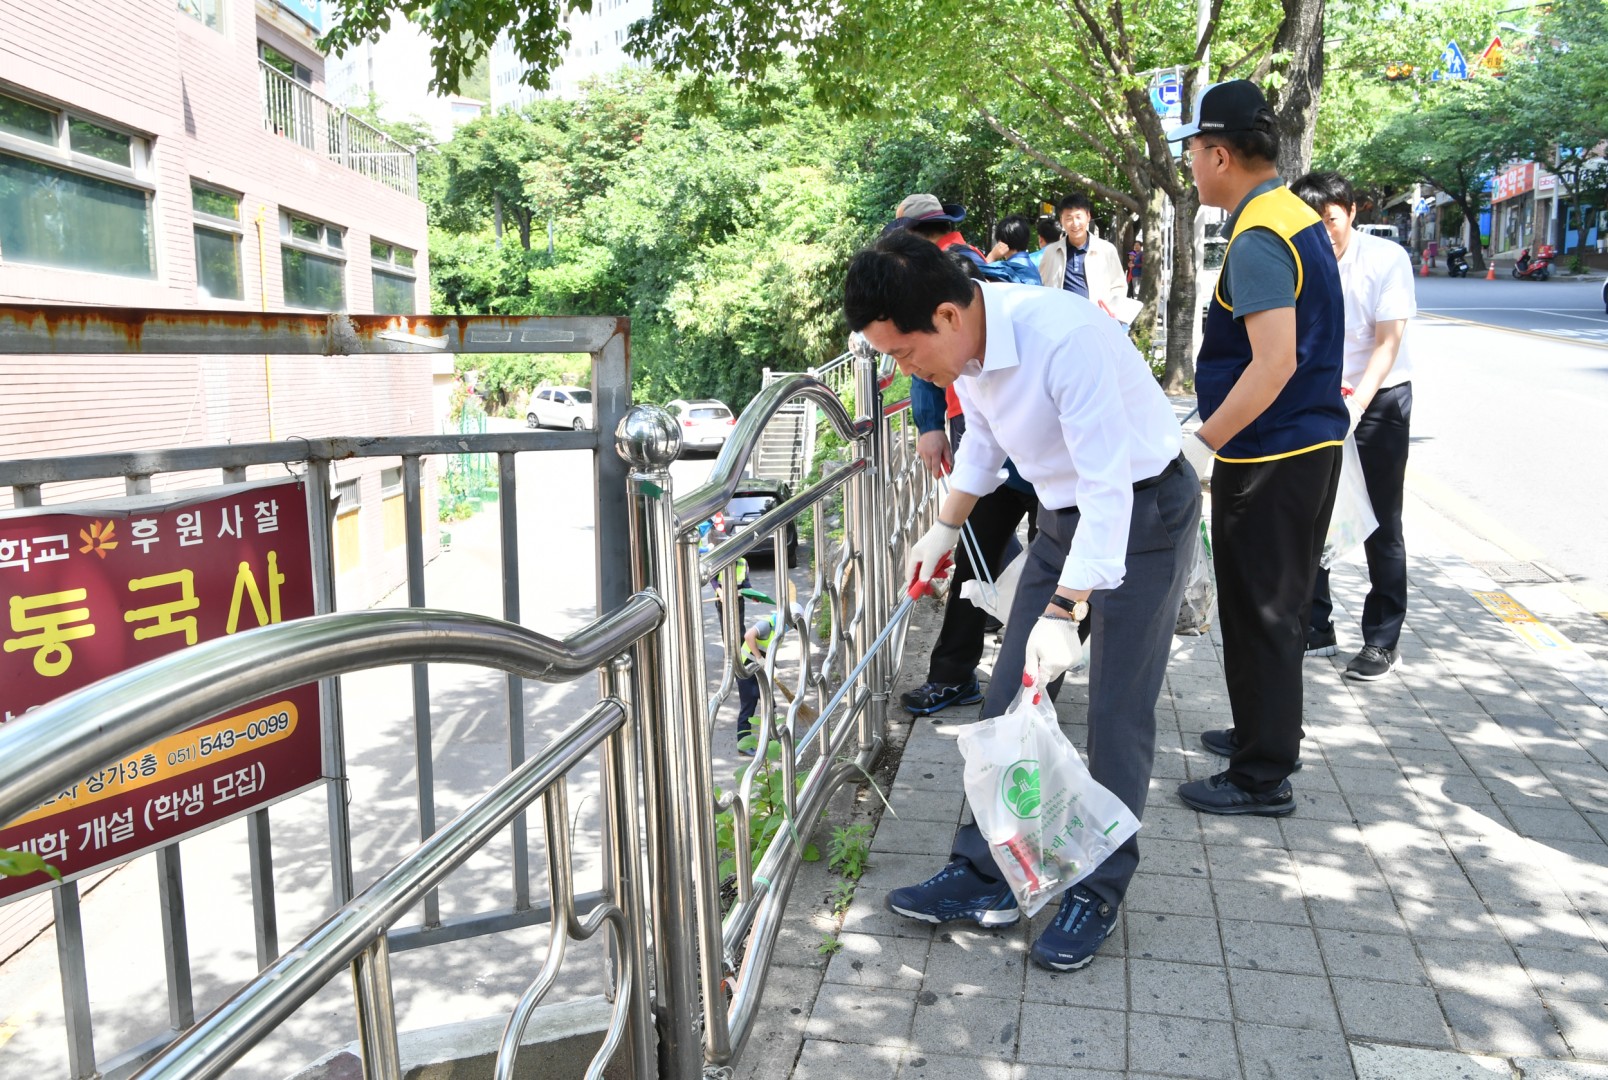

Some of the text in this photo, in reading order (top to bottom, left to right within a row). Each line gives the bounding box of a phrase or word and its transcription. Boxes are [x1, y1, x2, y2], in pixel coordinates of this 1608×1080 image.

[0, 534, 70, 572] 학교
[3, 550, 286, 677] 동국사
[86, 711, 290, 793] 상가3층 051) 543-0099
[77, 806, 135, 852] 개설
[144, 782, 205, 831] (학생
[212, 761, 267, 806] 모집)
